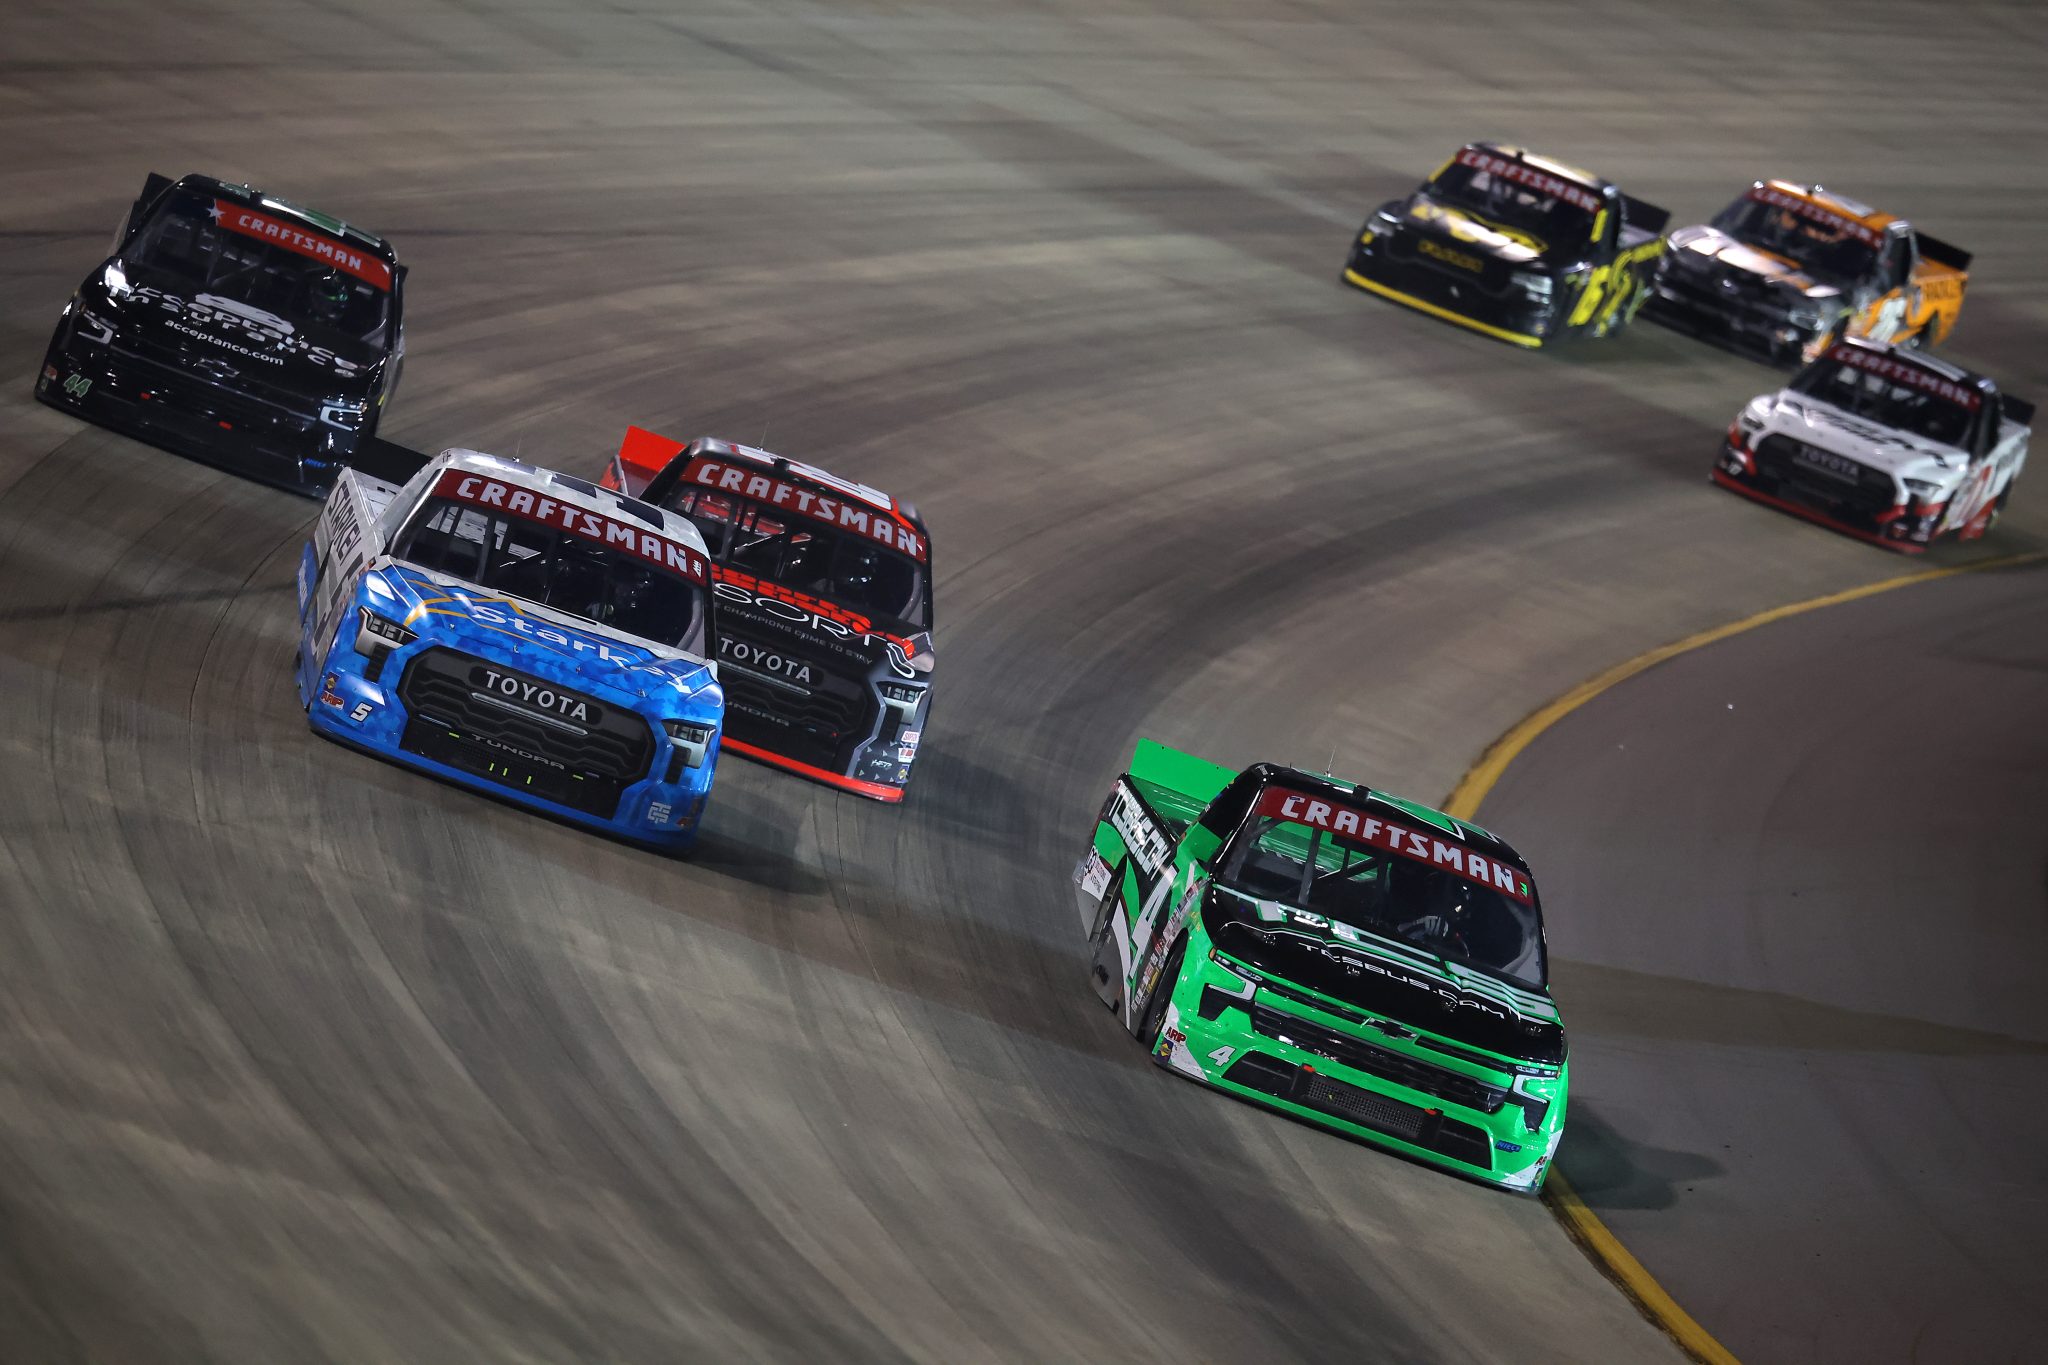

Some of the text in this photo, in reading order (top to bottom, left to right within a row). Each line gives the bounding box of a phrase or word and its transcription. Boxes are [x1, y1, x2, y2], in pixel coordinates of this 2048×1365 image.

[1459, 151, 1597, 211] CRAFTSMAN
[238, 213, 362, 270] CRAFTSMAN
[164, 319, 285, 366] acceptance.com
[63, 374, 93, 398] 44
[1835, 349, 1971, 406] CRAFTSMAN
[1802, 447, 1859, 475] TOYOTA
[327, 480, 362, 567] STARKEY
[457, 477, 688, 573] CRAFTSMAN
[697, 463, 917, 556] CRAFTSMAN
[723, 605, 793, 634] CHAMPIONS
[794, 629, 825, 646] COME
[720, 637, 810, 683] TOYOTA
[350, 702, 373, 722] 5
[486, 670, 587, 721] TOYOTA
[724, 701, 790, 728] UNDRA
[471, 733, 565, 771] TUNDRA
[1280, 795, 1516, 894] CRAFTSMAN
[1207, 1045, 1236, 1067] 4
